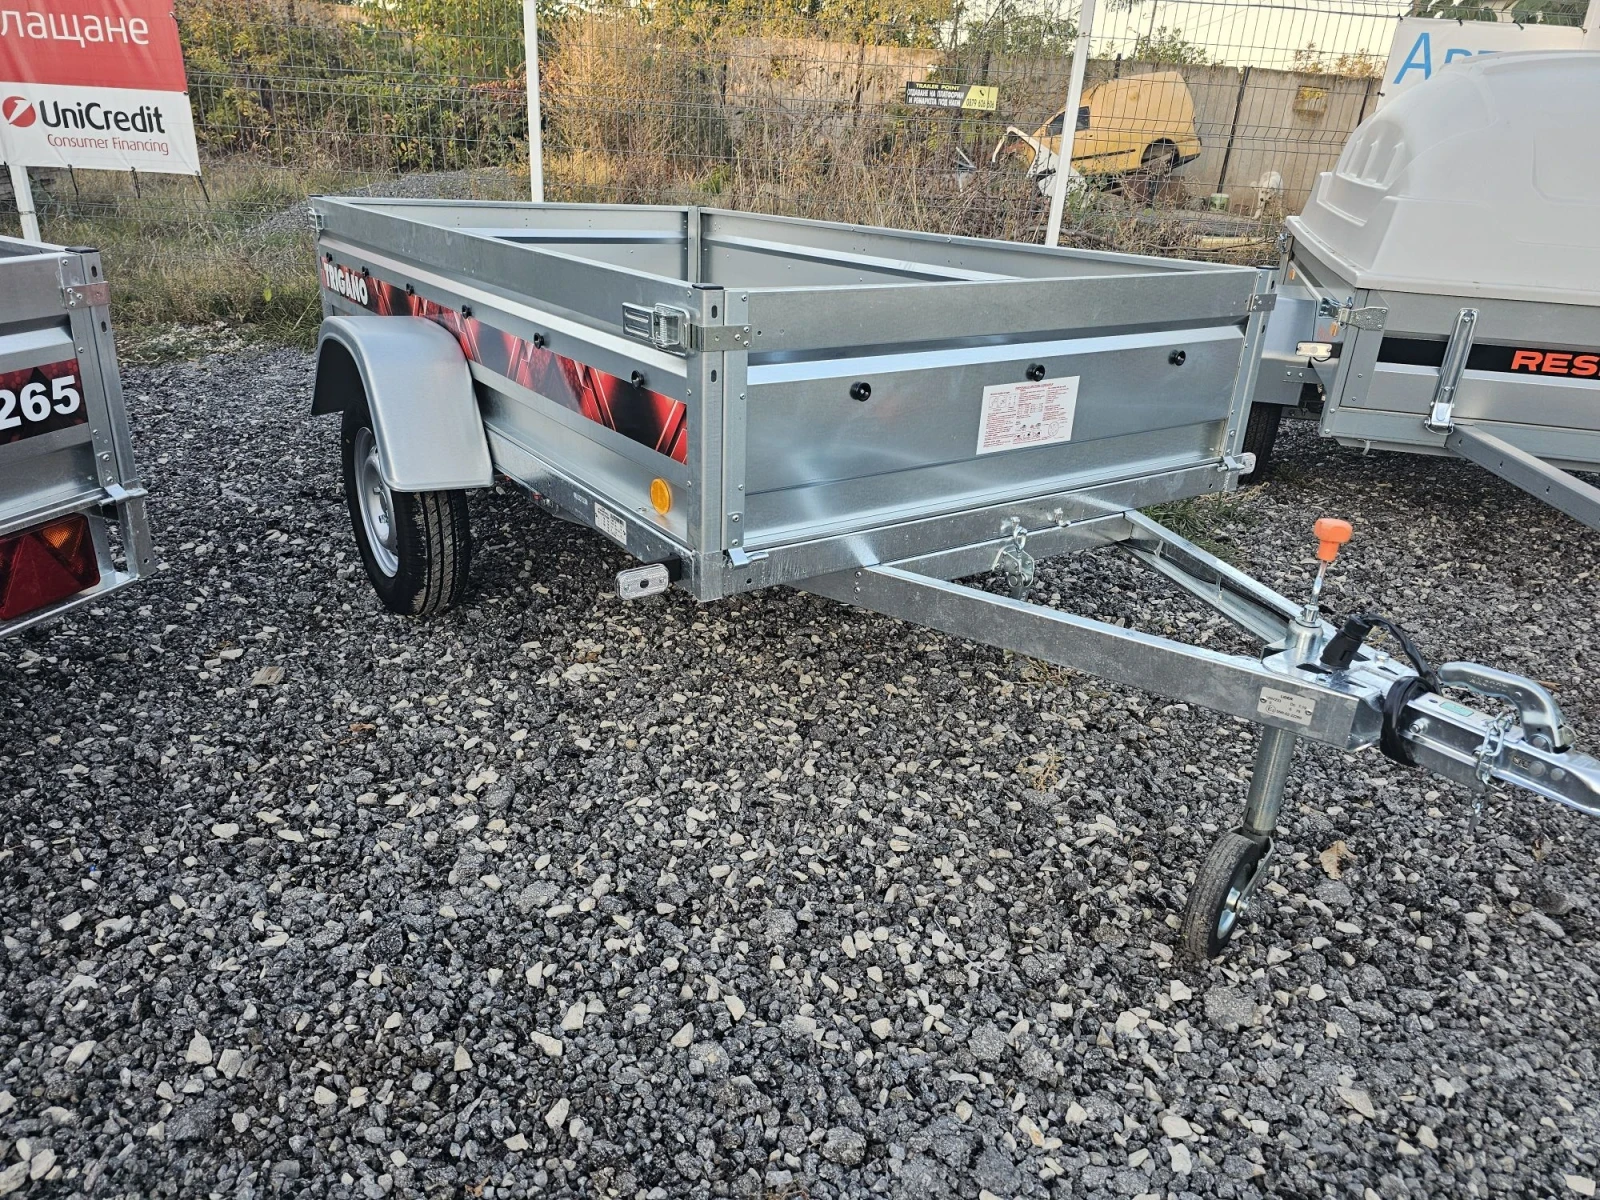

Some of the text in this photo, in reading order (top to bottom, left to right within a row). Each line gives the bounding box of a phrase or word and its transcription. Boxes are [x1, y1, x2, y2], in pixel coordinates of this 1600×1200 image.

[0, 10, 149, 48] лащане
[39, 100, 165, 133] UniCredit
[47, 133, 169, 155] Consumer Financing
[323, 262, 368, 305] TRIGANO
[1511, 350, 1600, 376] RES
[0, 375, 80, 430] 265
